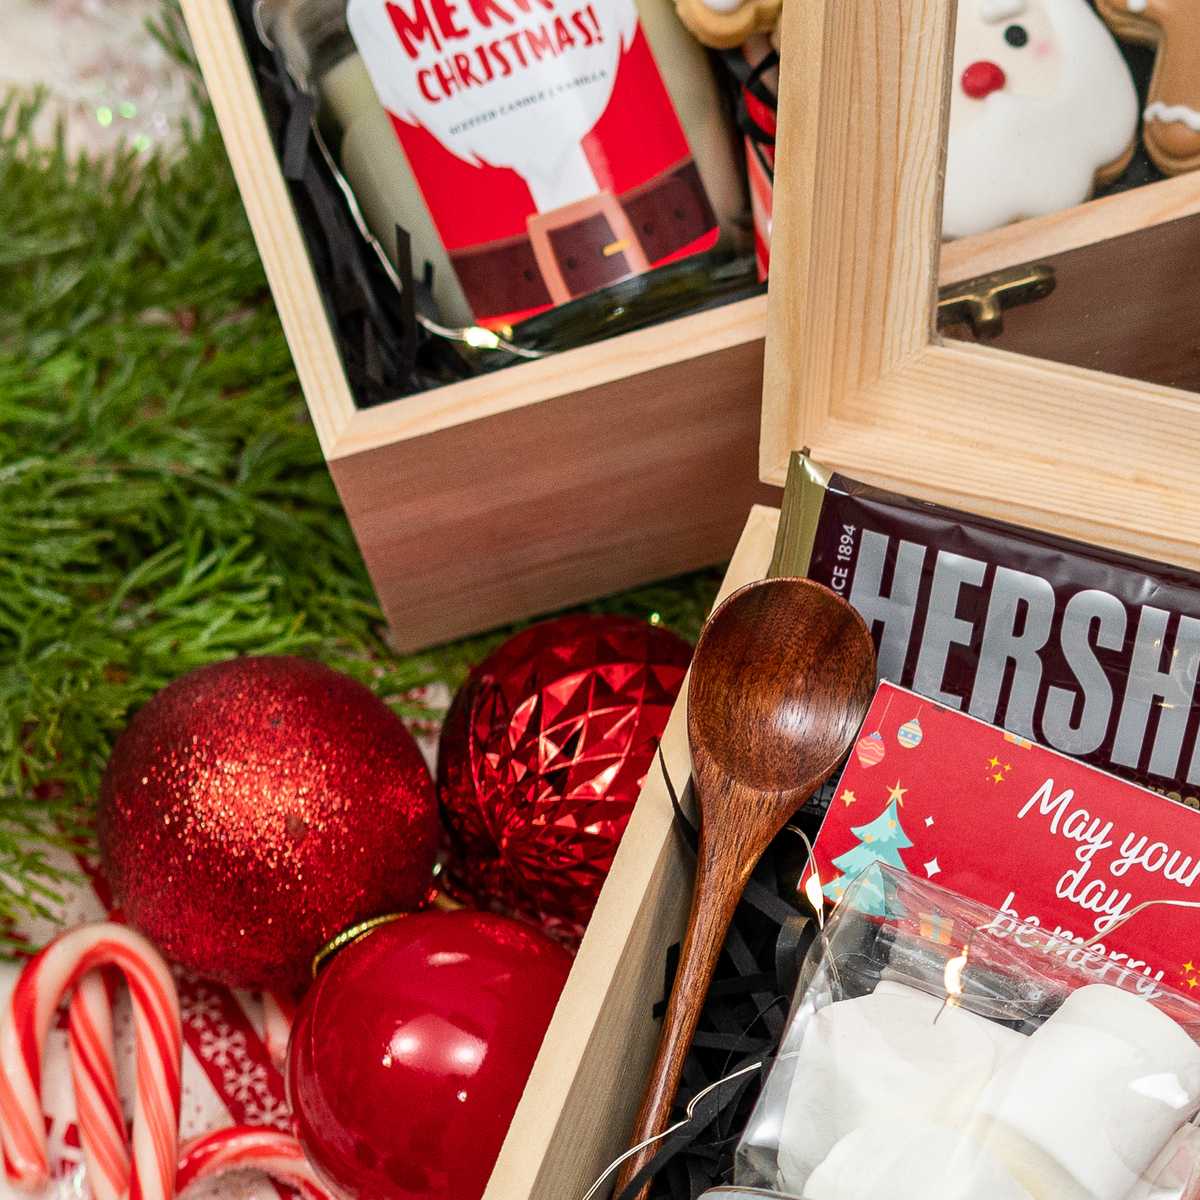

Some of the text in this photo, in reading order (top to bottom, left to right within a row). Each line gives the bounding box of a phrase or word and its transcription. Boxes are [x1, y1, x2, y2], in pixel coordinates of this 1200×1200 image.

[417, 5, 604, 102] CHRISTMAS!
[836, 523, 856, 561] 1894
[1016, 778, 1113, 862] May
[1055, 861, 1132, 931] day
[986, 891, 1166, 1000] be merry
